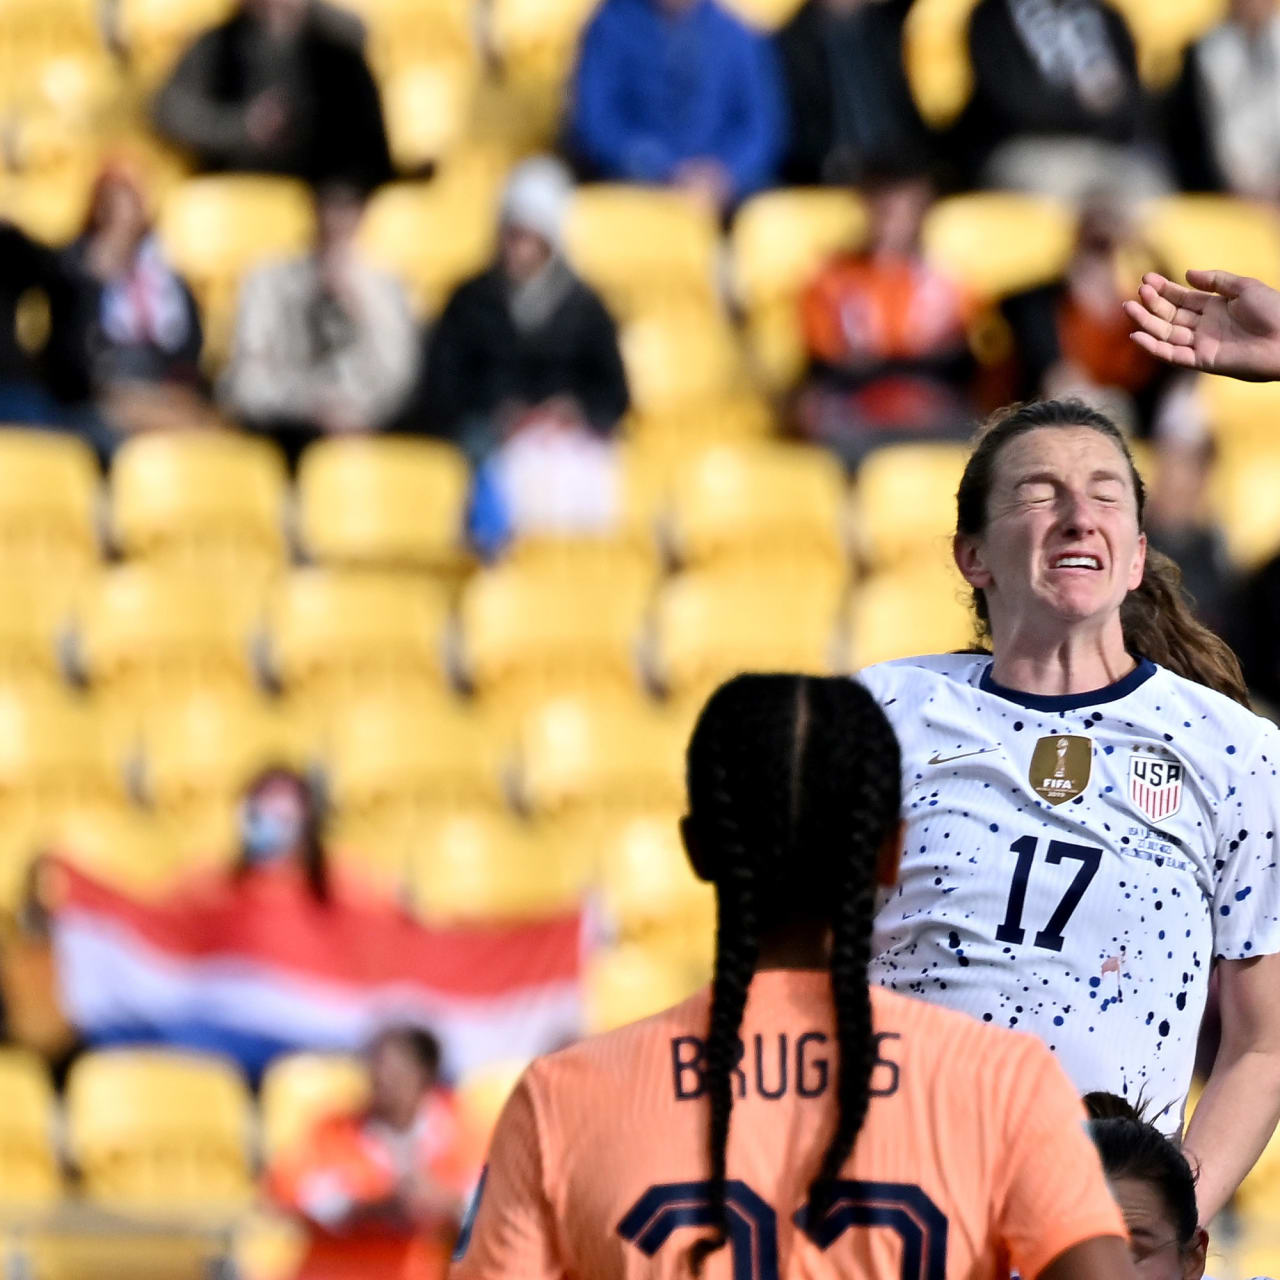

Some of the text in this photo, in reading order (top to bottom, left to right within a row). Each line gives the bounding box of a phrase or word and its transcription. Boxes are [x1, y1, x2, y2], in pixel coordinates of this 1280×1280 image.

[1043, 778, 1073, 790] FIFA
[1134, 760, 1180, 787] USA
[995, 835, 1104, 953] 17
[670, 1031, 901, 1101] BUGS
